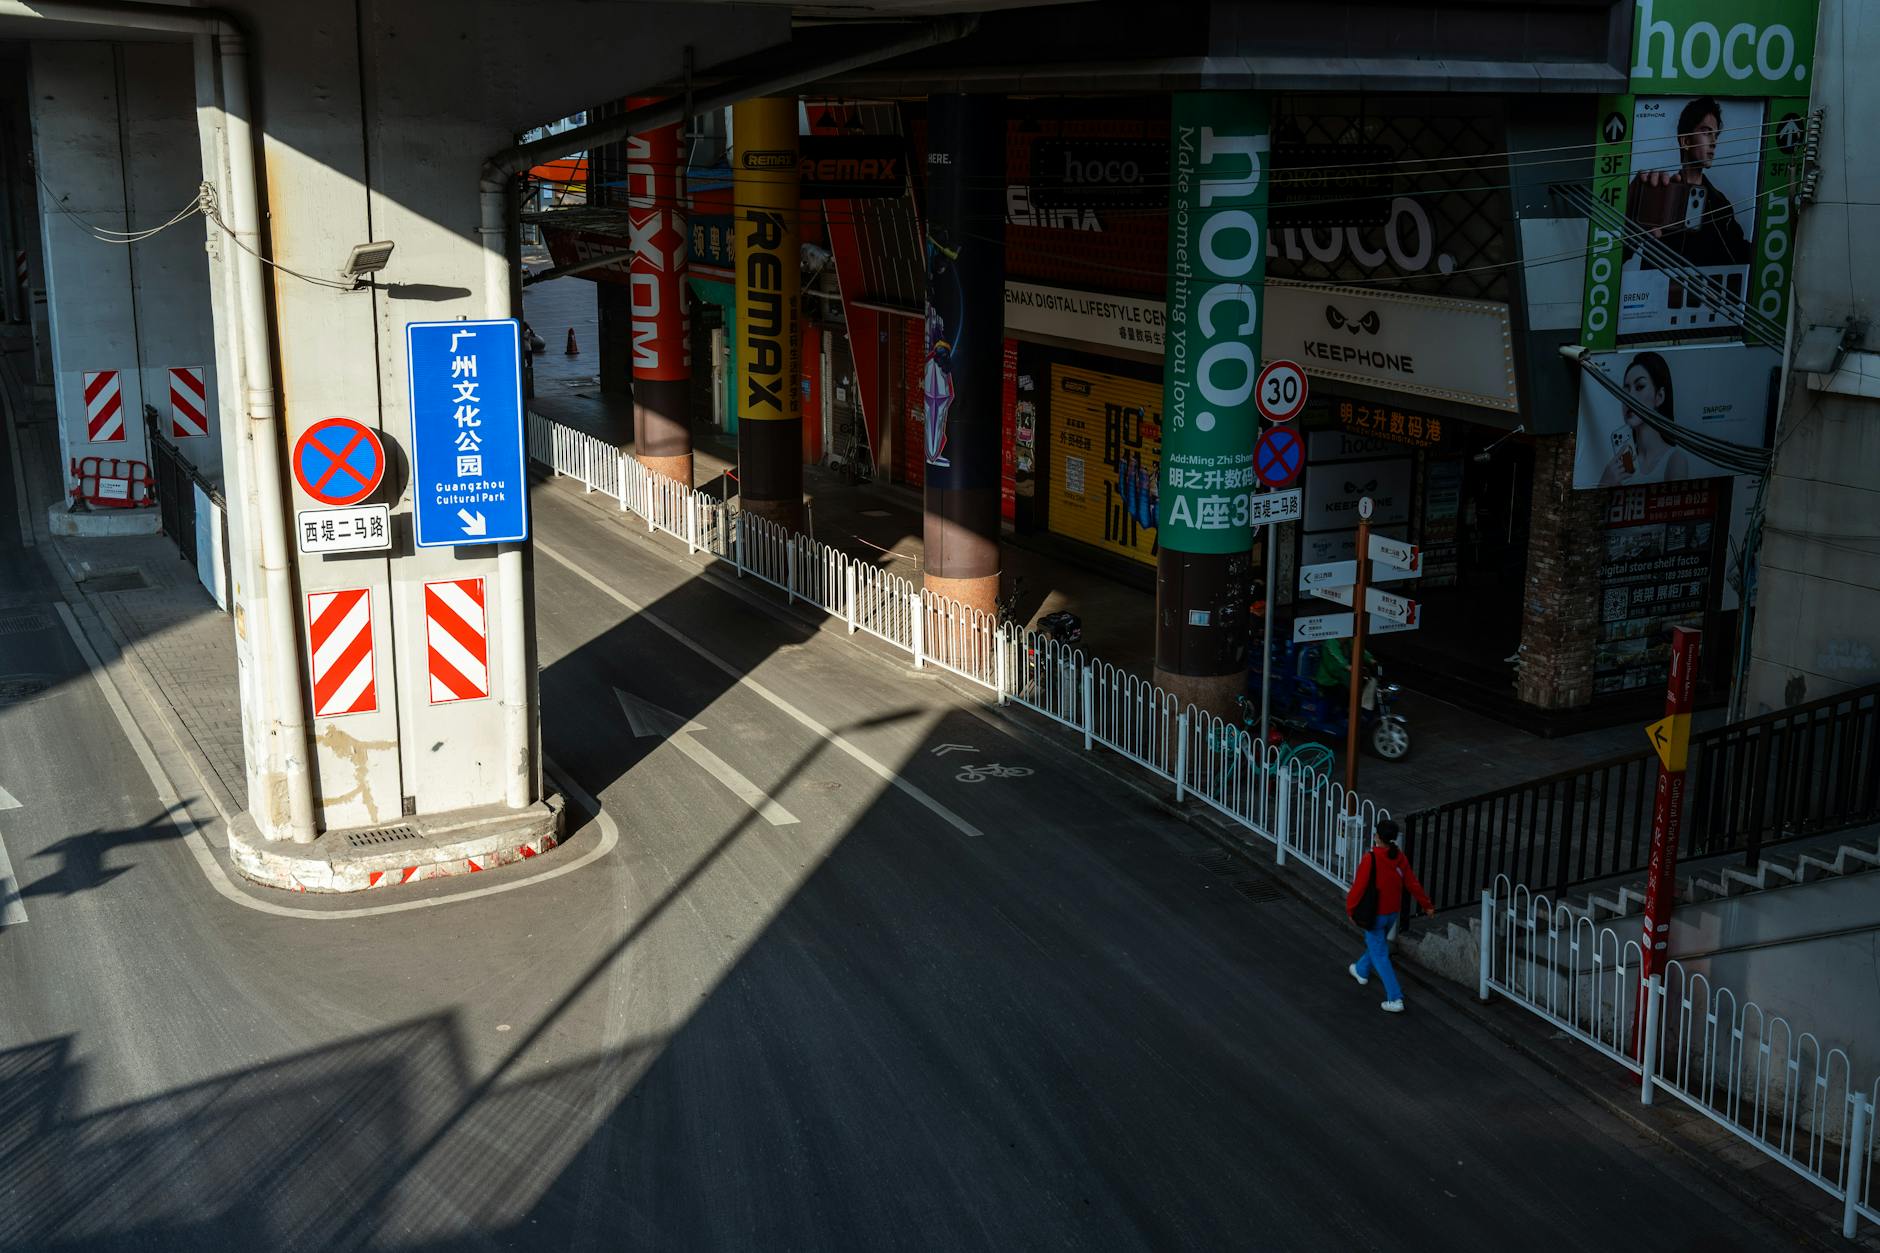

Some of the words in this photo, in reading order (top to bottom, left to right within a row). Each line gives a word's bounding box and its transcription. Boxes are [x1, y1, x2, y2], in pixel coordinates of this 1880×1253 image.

[1631, 0, 1806, 81] hoco.
[749, 155, 792, 166] REMAX
[1062, 151, 1144, 184] hoco.
[1178, 126, 1194, 194] Make
[1600, 156, 1623, 174] 3F
[1172, 200, 1192, 324] something
[1195, 126, 1271, 432] hoco.
[746, 210, 789, 412] REMAX
[1036, 293, 1079, 313] DIGITAL
[1080, 300, 1141, 322] LIFESTYLE
[1172, 327, 1187, 373] you
[1304, 340, 1415, 374] KEEPHONE
[449, 329, 483, 478] 广州文化公园
[1173, 381, 1190, 432] love.
[1267, 376, 1297, 405] 30
[1340, 400, 1441, 442] 明之升数码港
[1217, 455, 1233, 464] Zhi
[436, 480, 505, 493] Guangzhou
[436, 494, 480, 505] Cultural
[482, 492, 505, 503] Park
[1253, 495, 1299, 519] 西堤二马路
[305, 515, 385, 543] 西堤二马路
